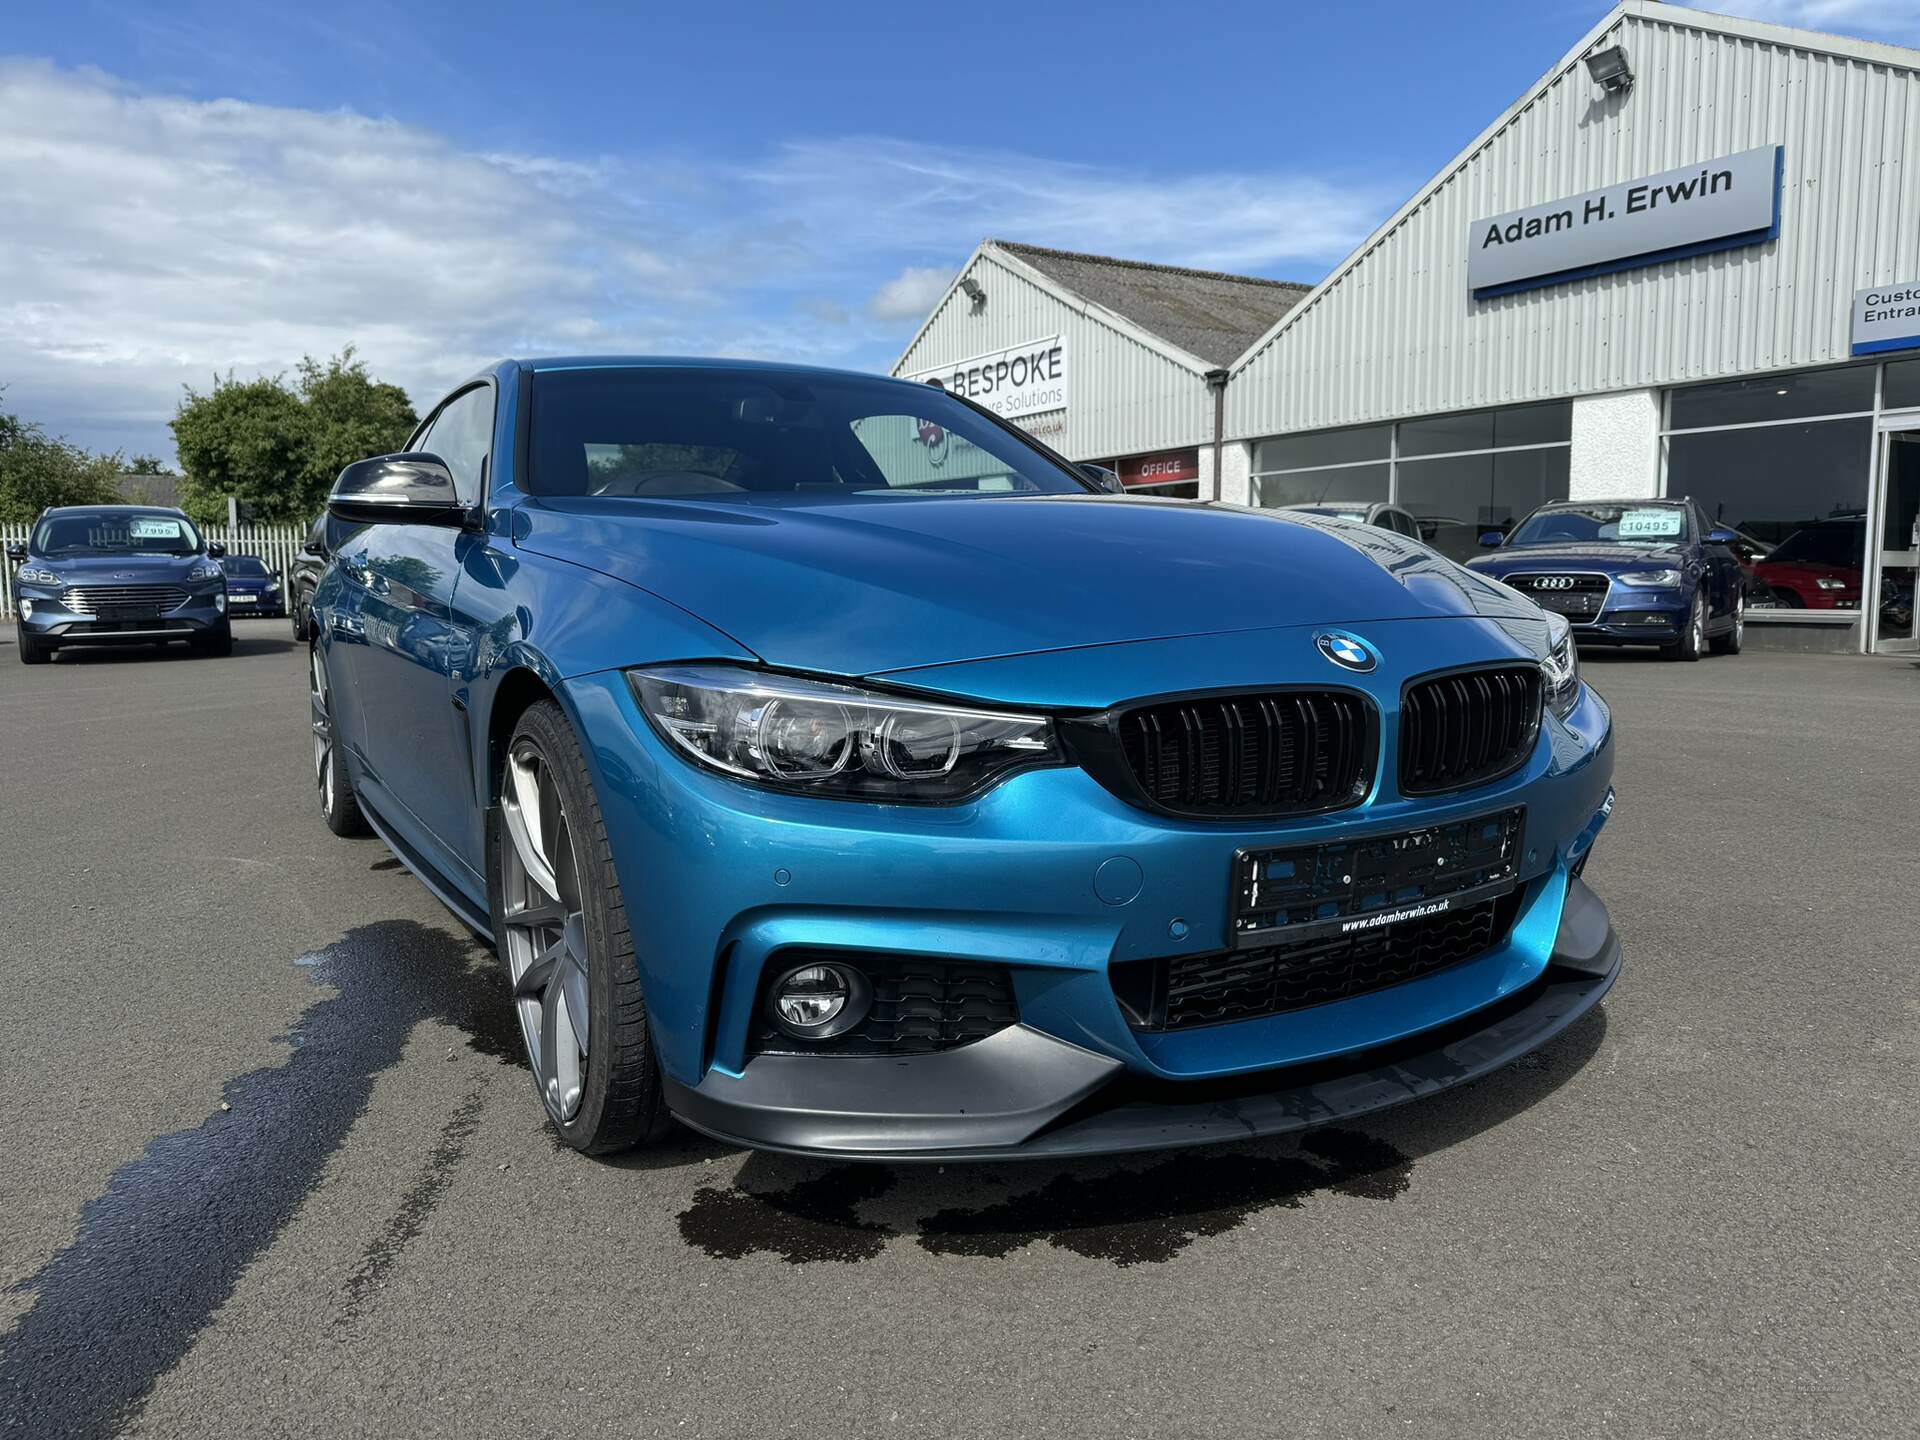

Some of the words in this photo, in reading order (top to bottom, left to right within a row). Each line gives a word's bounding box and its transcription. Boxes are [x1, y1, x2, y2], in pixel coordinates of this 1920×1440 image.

[1482, 210, 1573, 249] Adam
[1583, 196, 1615, 224] H.
[1626, 169, 1733, 214] Erwin
[1864, 306, 1920, 323] Entra
[953, 346, 1062, 398] BESPOKE
[1006, 388, 1063, 412] Solutions
[1141, 460, 1181, 477] OFFICE
[1341, 898, 1450, 932] www.adamherwin.co.uk
